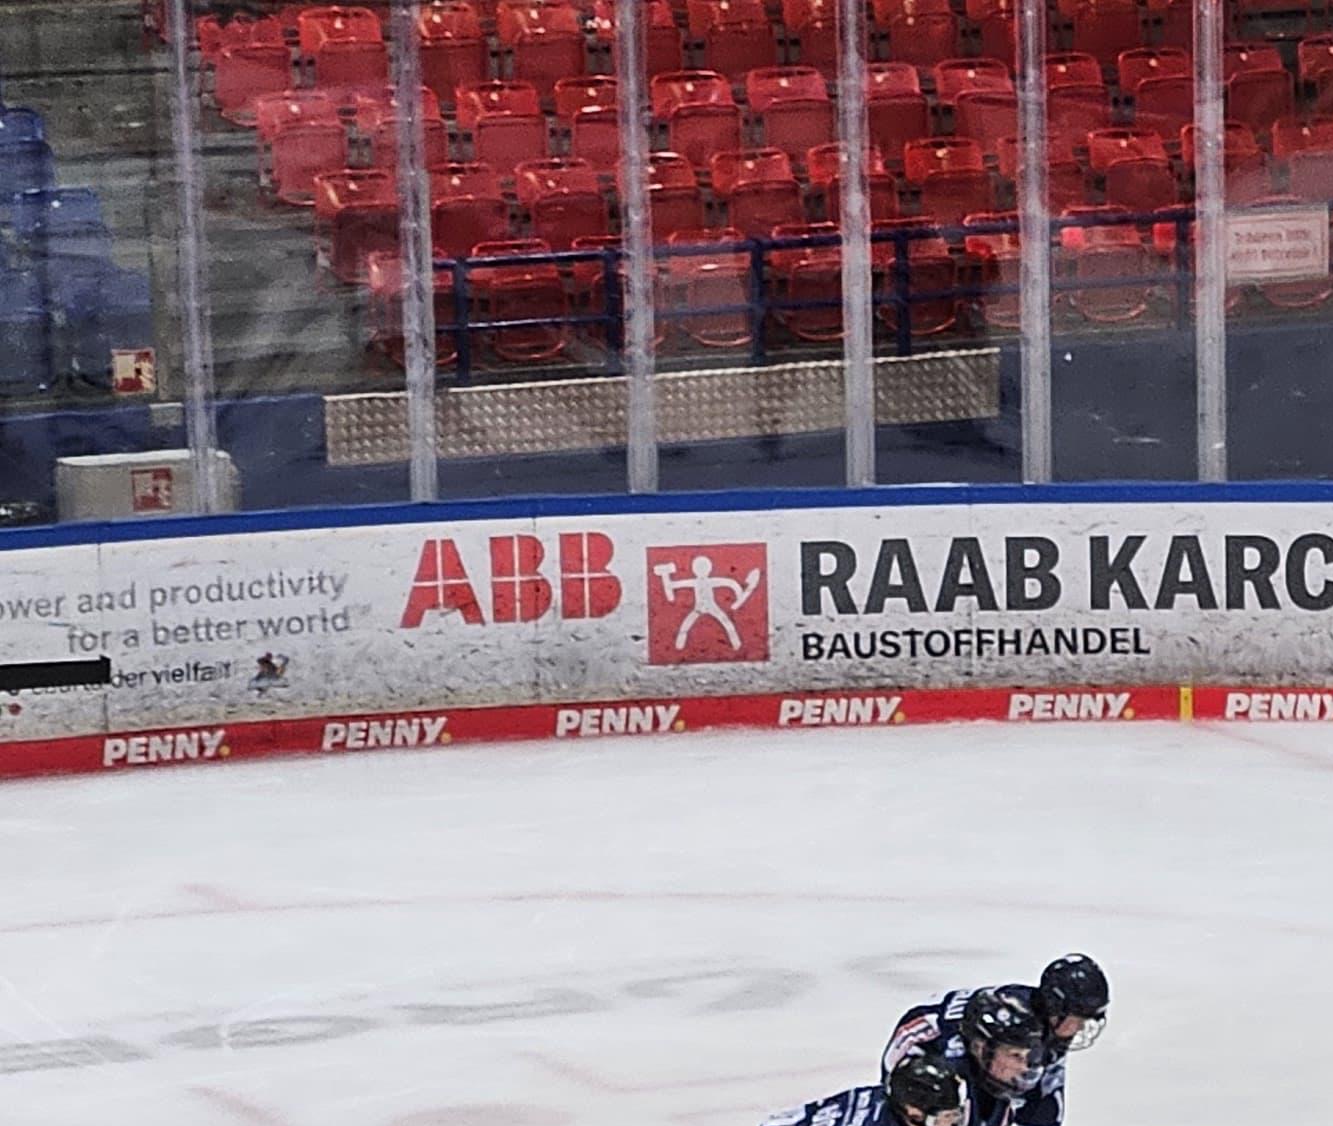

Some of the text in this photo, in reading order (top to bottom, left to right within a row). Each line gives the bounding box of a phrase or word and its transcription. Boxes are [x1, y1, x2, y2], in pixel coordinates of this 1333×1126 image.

[77, 582, 137, 615] and
[149, 571, 349, 609] productivity
[401, 533, 623, 629] ABB
[800, 536, 1062, 616] RAAB
[67, 607, 350, 655] for a better world
[803, 628, 1150, 660] BAUSTOFFHANDEL
[111, 669, 147, 690] der
